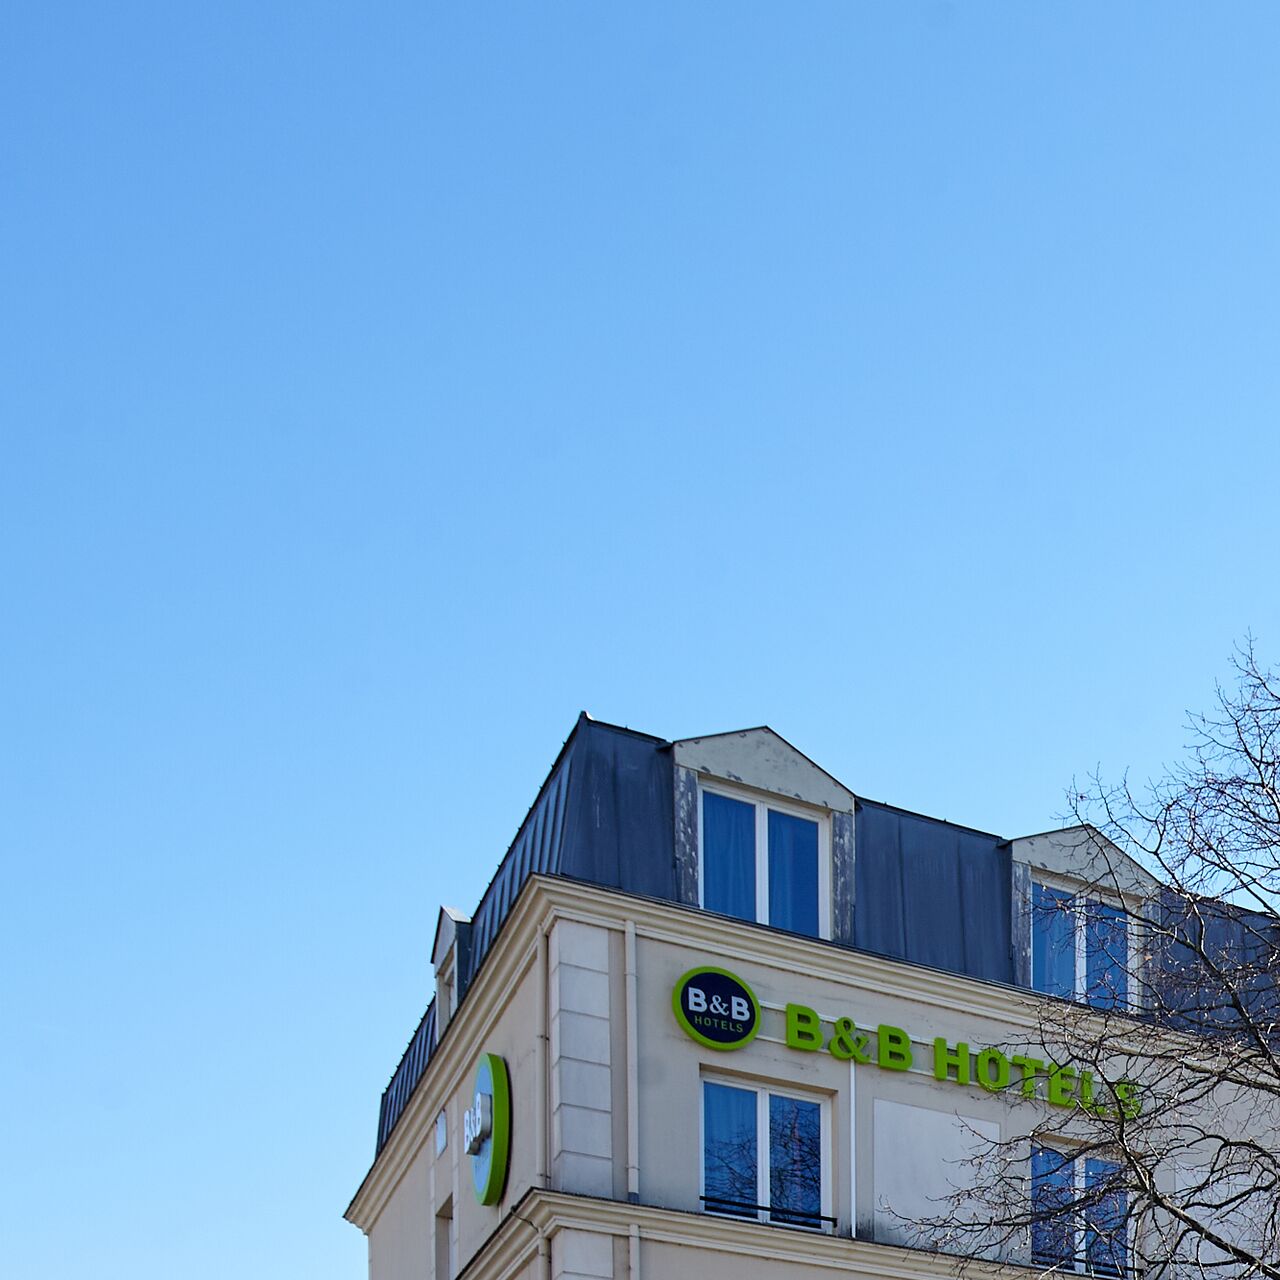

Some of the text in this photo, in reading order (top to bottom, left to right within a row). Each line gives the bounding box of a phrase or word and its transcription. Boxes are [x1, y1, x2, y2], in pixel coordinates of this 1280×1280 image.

[688, 986, 751, 1022] B&B
[694, 1014, 744, 1033] HOTELS
[785, 1002, 1143, 1121] B&B HOTELS
